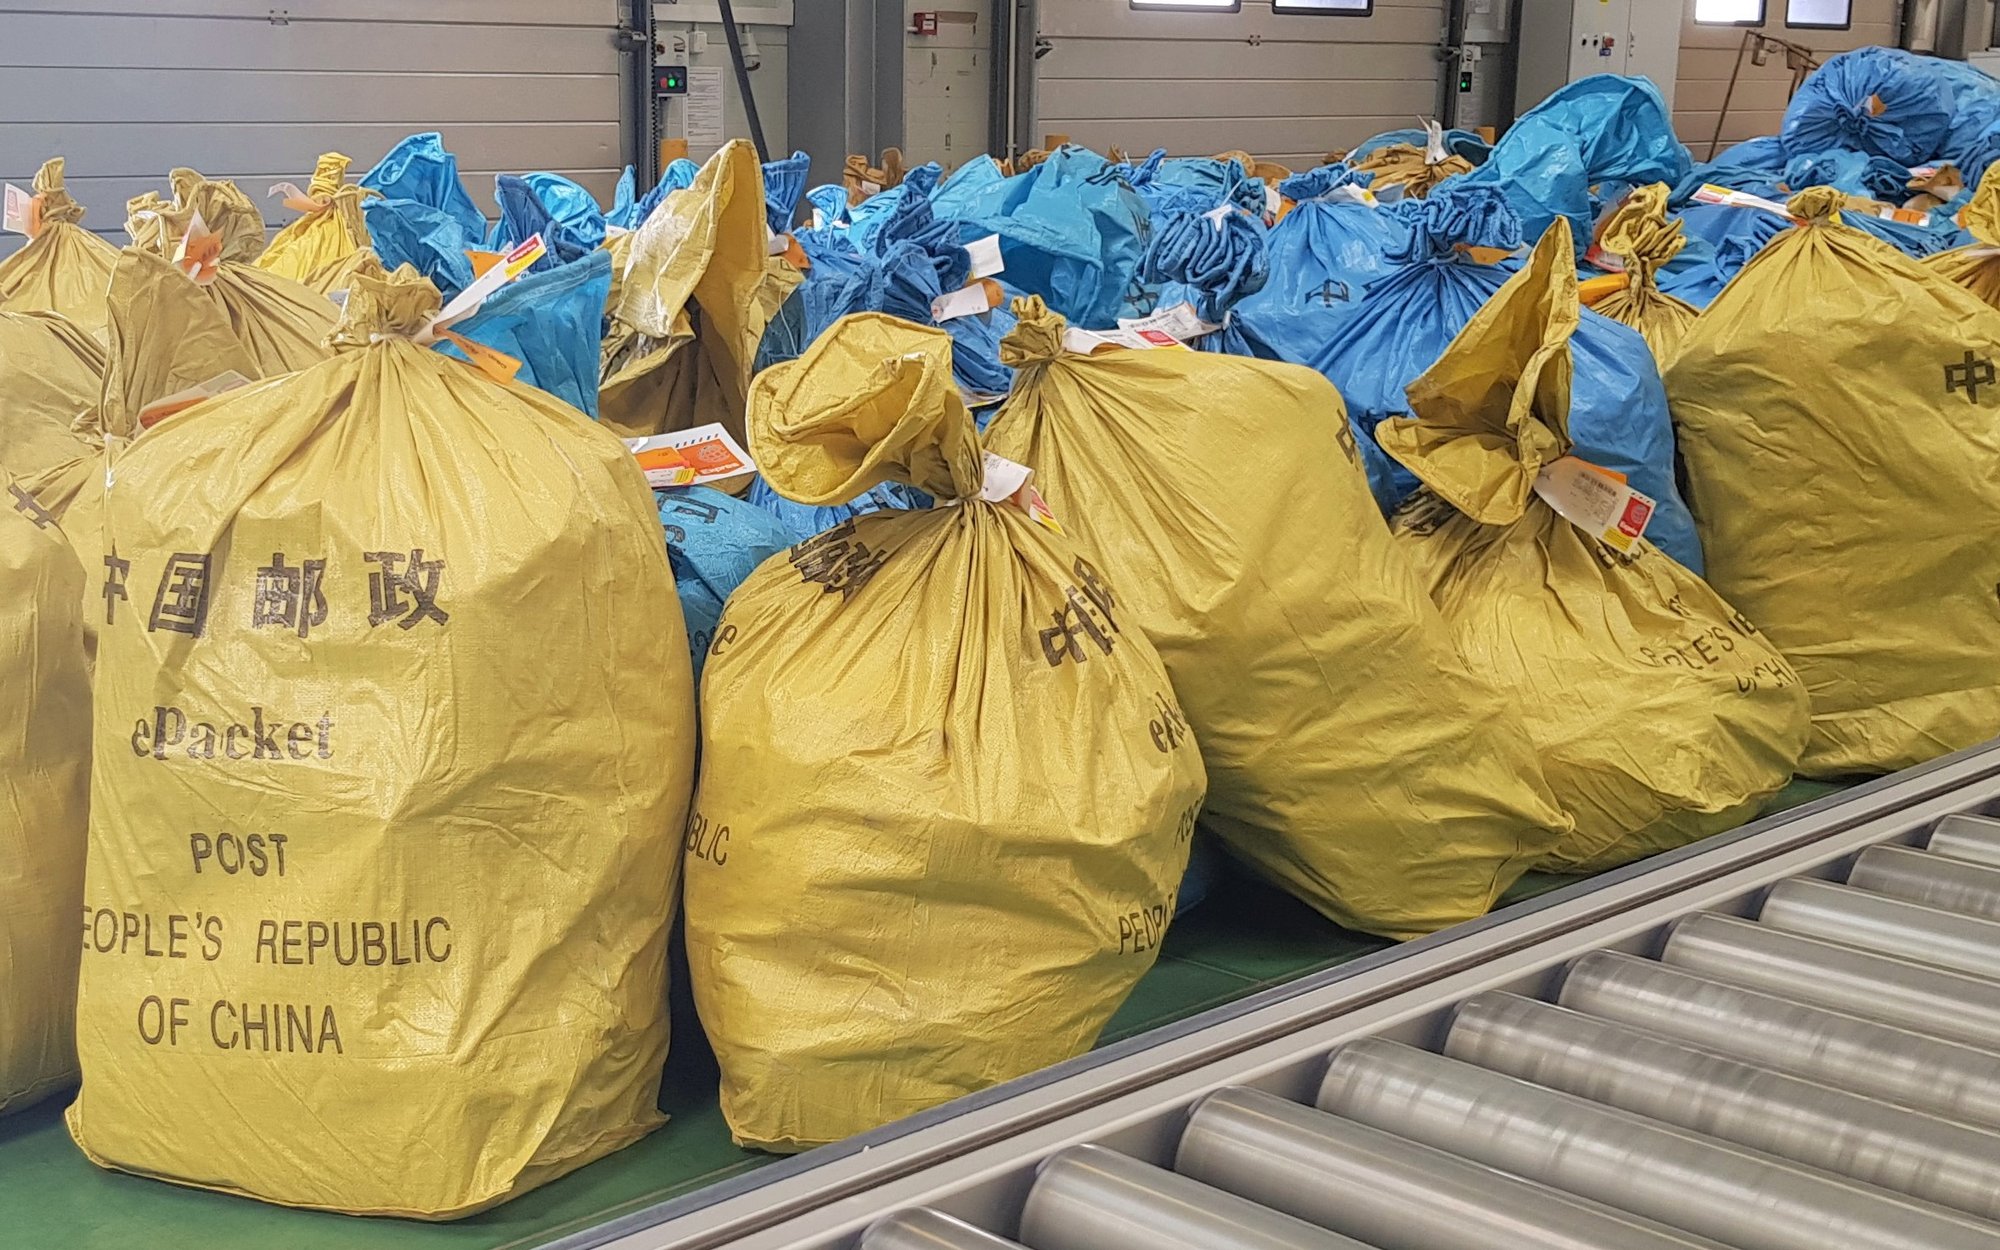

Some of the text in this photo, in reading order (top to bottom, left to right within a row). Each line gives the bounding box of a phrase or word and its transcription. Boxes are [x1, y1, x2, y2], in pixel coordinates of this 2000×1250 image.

[1944, 350, 1996, 405] 中
[102, 538, 450, 638] 中国邮政
[131, 706, 335, 761] ePacket
[190, 832, 288, 877] POST
[686, 812, 730, 867] BLIC
[256, 916, 451, 967] REPUBLIC
[138, 995, 343, 1054] OF CHINA
